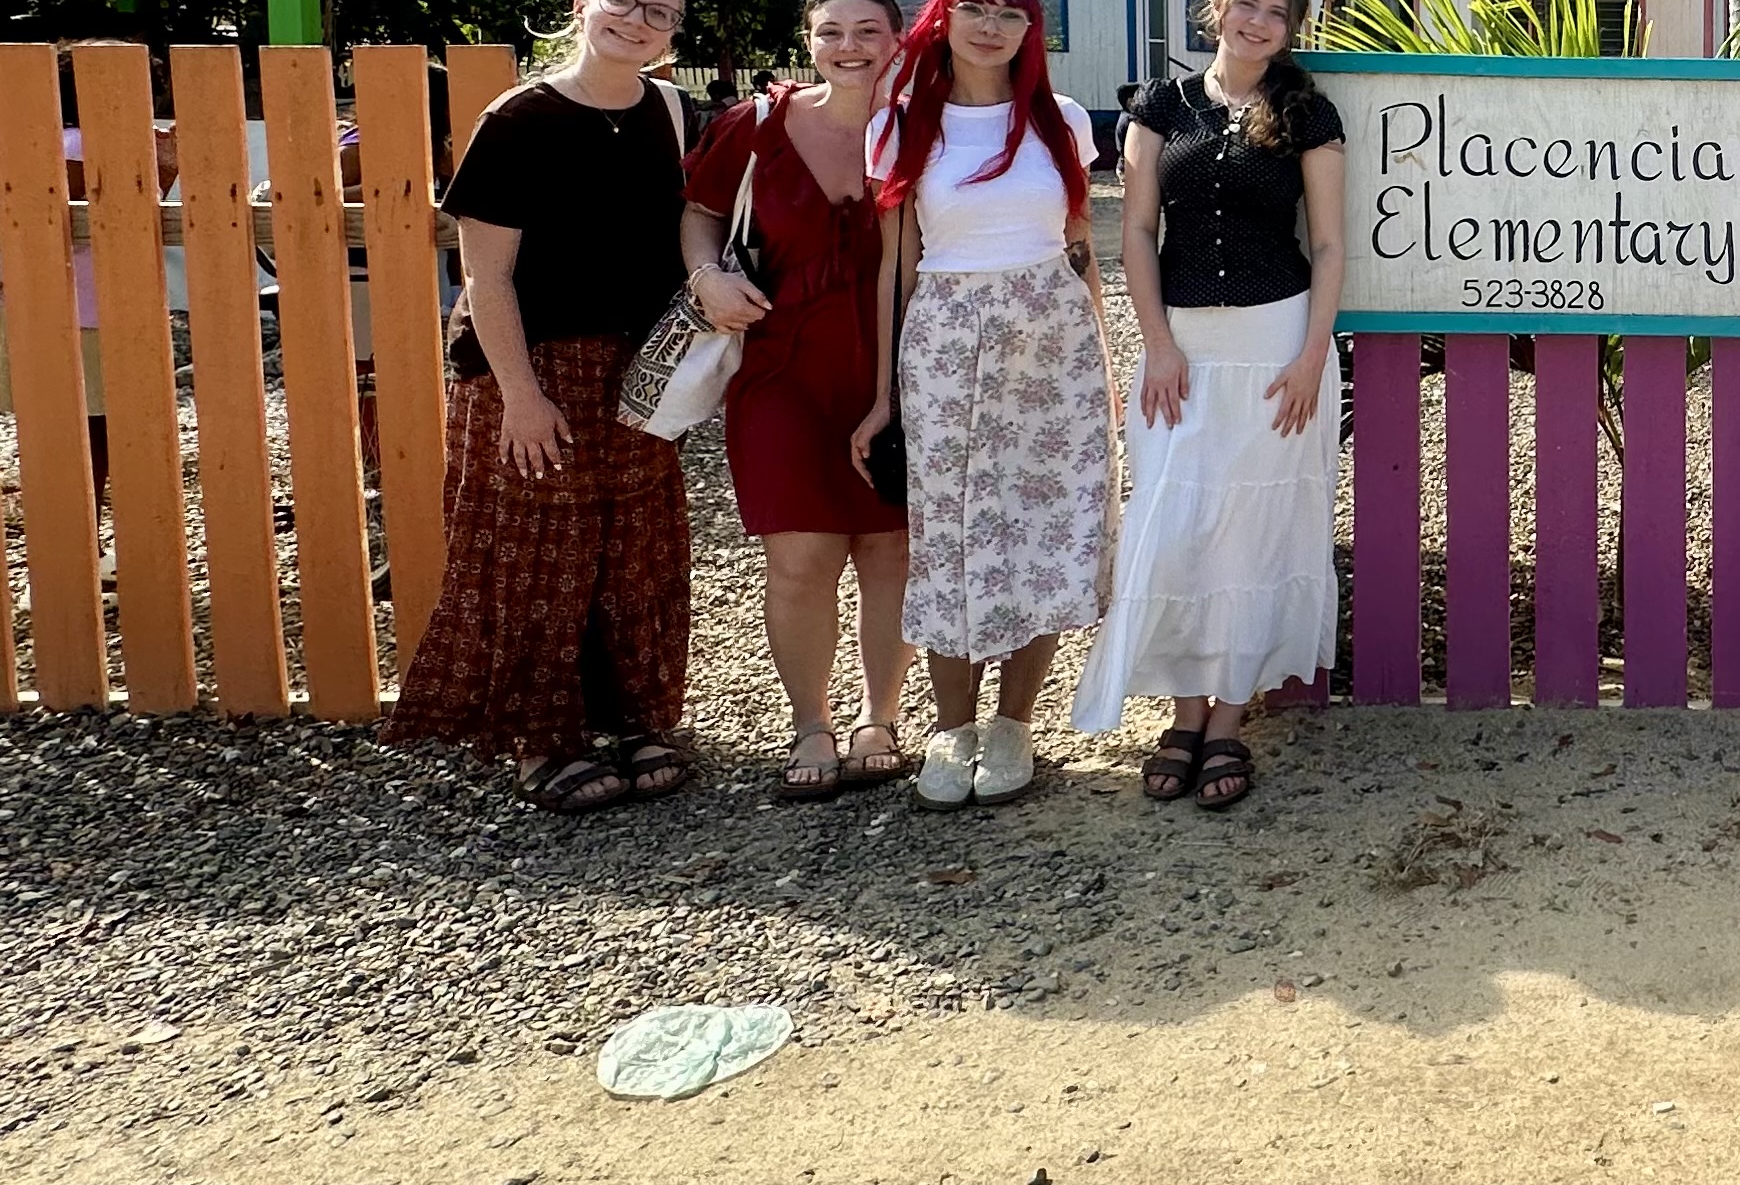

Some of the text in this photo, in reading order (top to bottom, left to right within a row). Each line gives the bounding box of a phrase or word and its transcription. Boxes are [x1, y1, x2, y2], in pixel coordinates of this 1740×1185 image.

[1379, 93, 1735, 181] Placencia
[1371, 180, 1736, 285] Elementary
[1461, 278, 1605, 310] 523-3828
